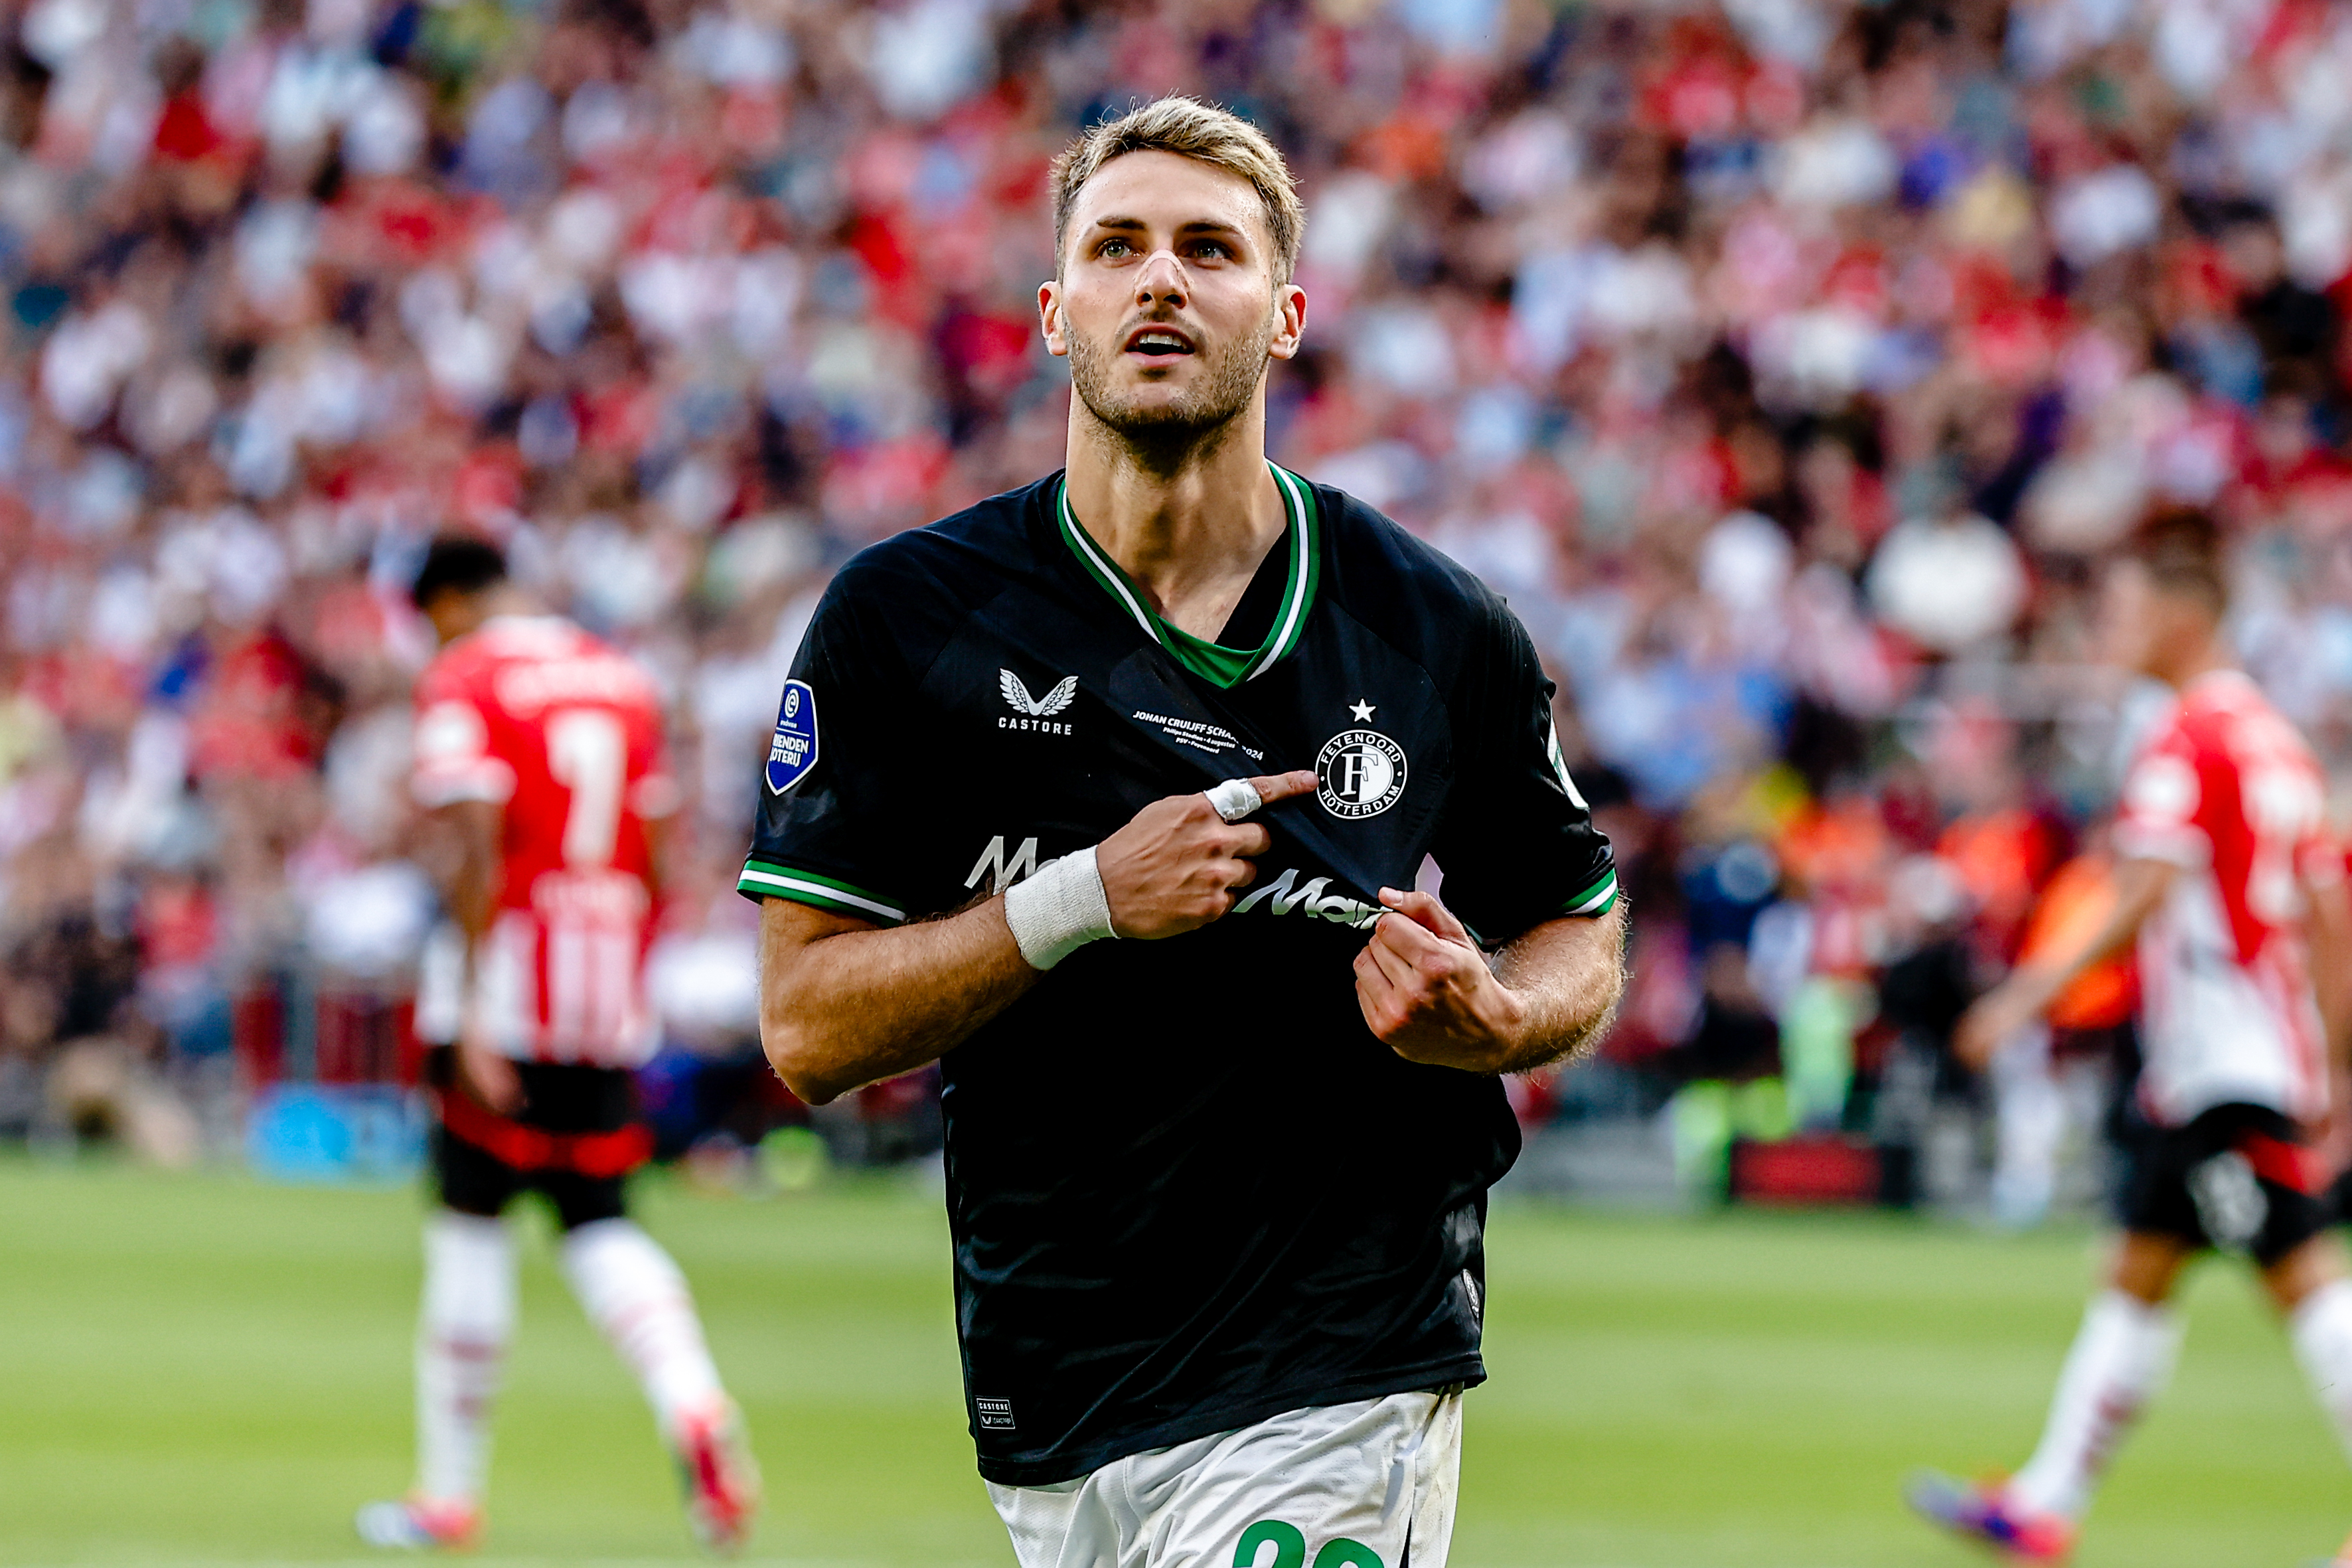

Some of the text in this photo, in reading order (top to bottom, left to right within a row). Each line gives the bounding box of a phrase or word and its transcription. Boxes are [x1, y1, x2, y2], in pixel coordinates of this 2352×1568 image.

[998, 717, 1071, 735] CASTORE
[1133, 711, 1167, 724] JOHAN
[1168, 718, 1207, 733] CRUIJFF
[1206, 726, 1239, 744] SCHA
[1182, 732, 1203, 741] Stadion
[773, 733, 809, 753] RIENDEN
[1190, 740, 1220, 754] Feyenoord
[1321, 734, 1401, 763] FEYENOORD
[1340, 753, 1379, 796] F
[1321, 785, 1400, 816] ROTTERDAM
